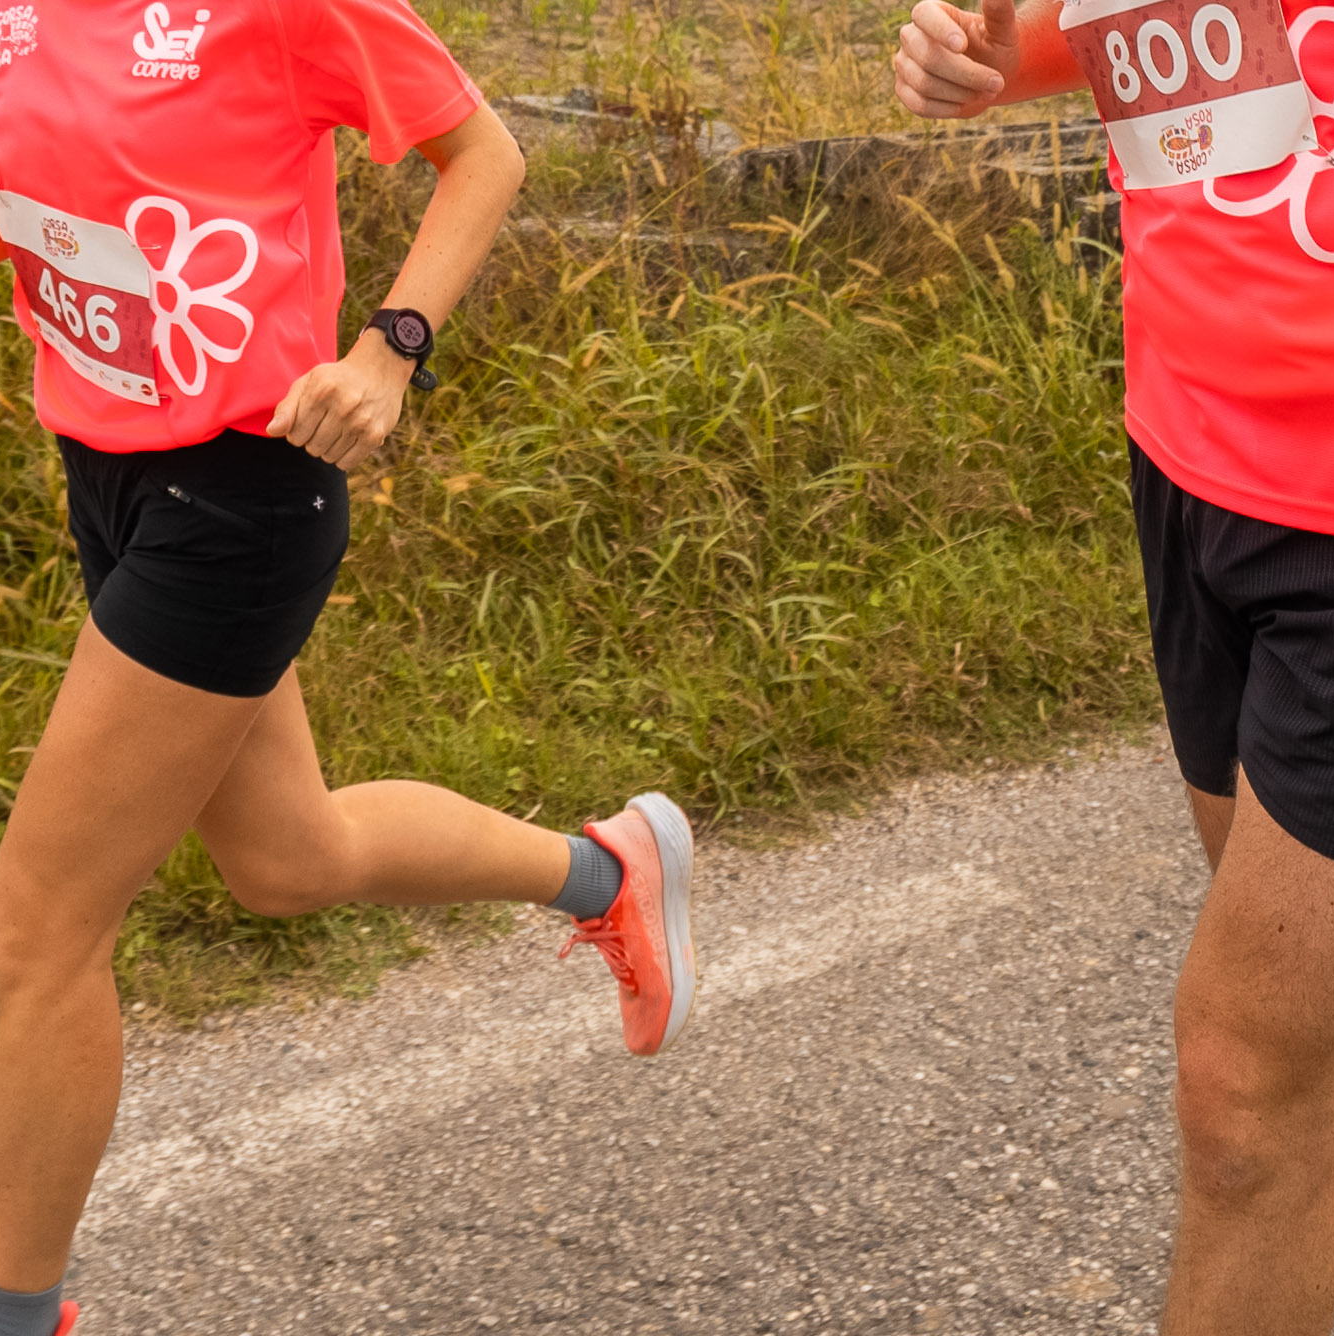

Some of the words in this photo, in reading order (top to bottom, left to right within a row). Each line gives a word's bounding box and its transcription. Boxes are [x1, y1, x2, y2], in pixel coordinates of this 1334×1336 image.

[131, 60, 201, 81] correre
[1184, 107, 1213, 131] ROSA
[1175, 151, 1207, 175] CORSA
[38, 267, 121, 354] 466
